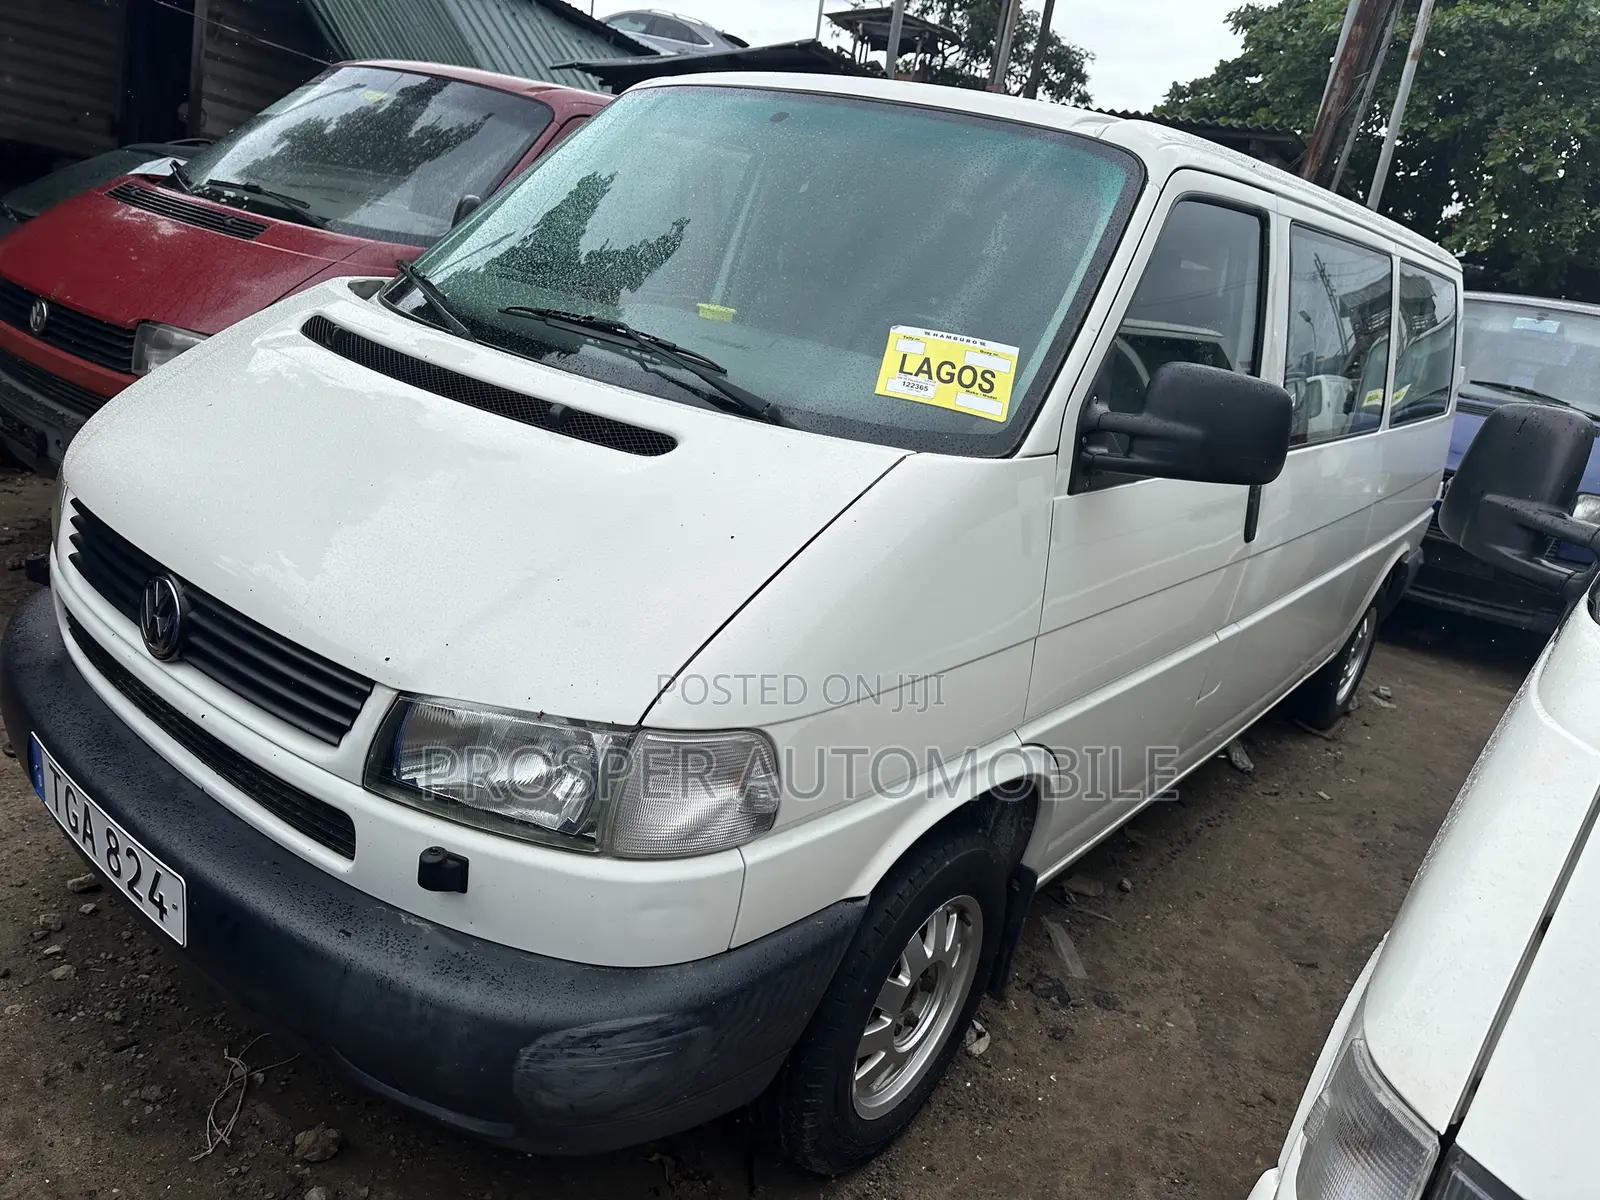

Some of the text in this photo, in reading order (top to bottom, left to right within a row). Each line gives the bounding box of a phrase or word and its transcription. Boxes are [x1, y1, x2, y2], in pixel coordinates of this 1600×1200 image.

[932, 332, 978, 345] HAMBURG
[898, 353, 996, 394] LAGOS
[902, 380, 929, 392] 122365
[49, 761, 169, 923] TGA 824
